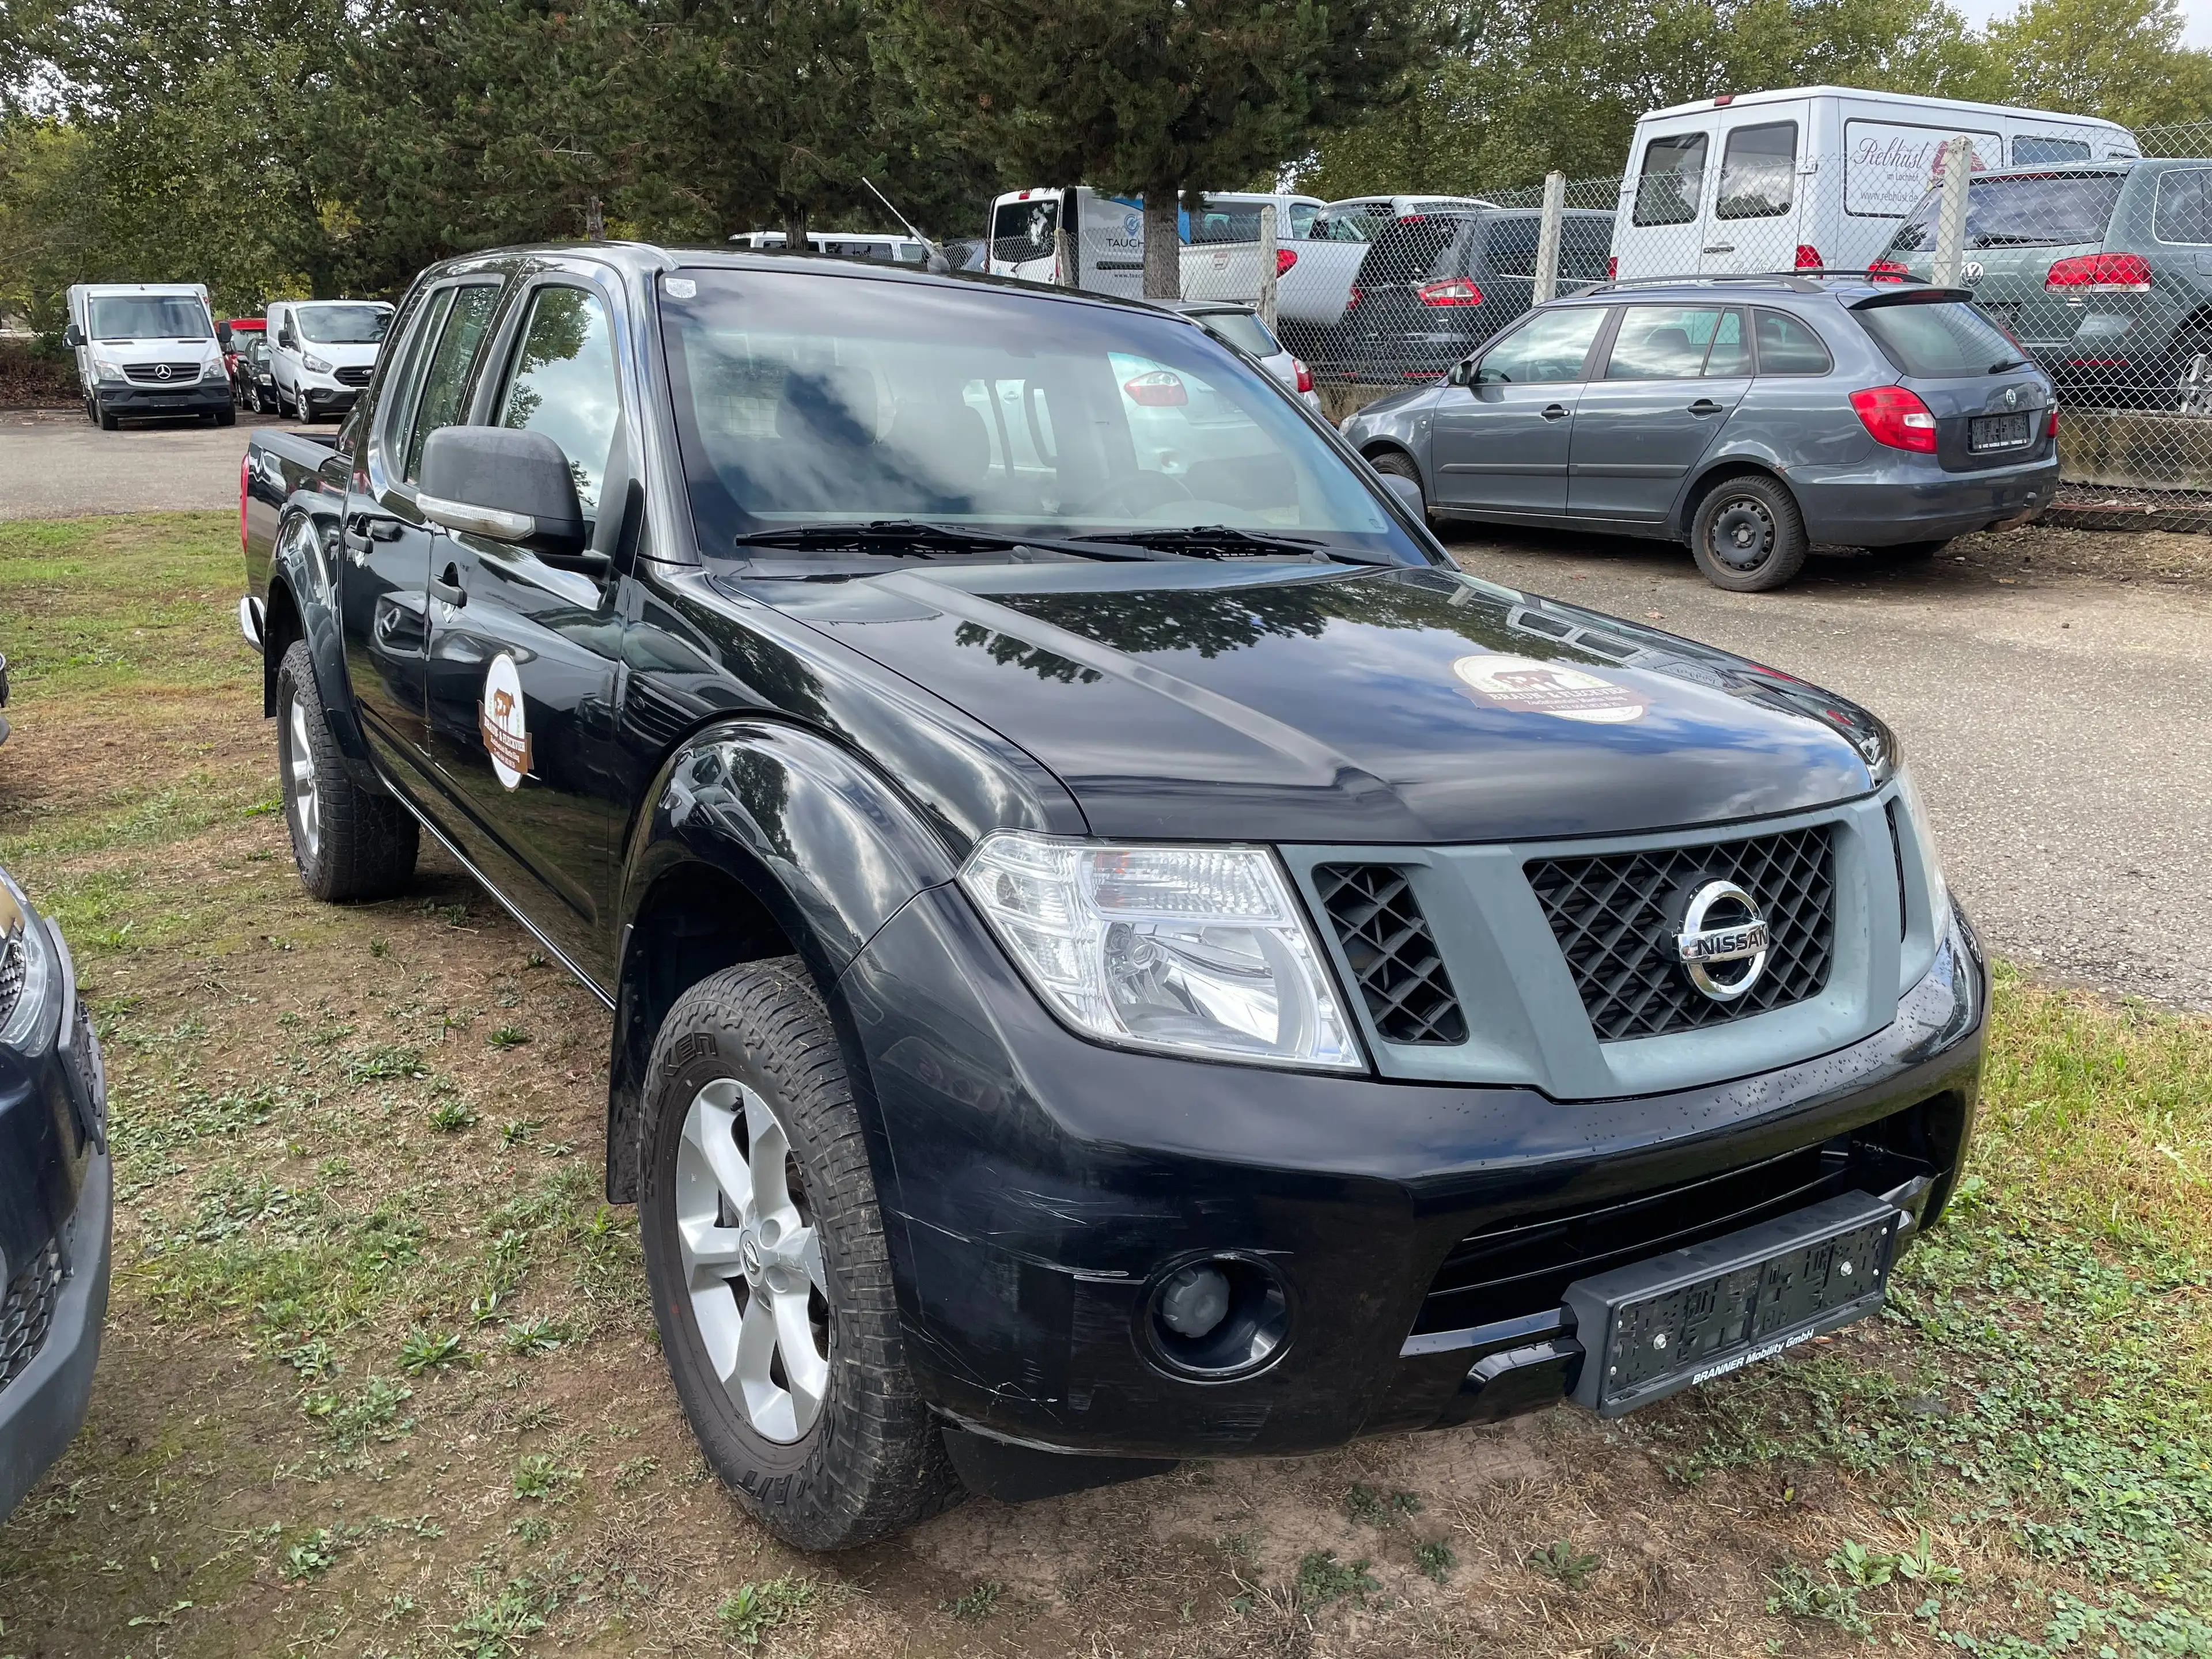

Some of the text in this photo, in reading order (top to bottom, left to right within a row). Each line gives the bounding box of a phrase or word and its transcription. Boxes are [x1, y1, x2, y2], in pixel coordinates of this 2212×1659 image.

[1696, 927, 1768, 956] NISSAN
[1692, 1328, 1814, 1385] BRANNER Mobility GmbH
